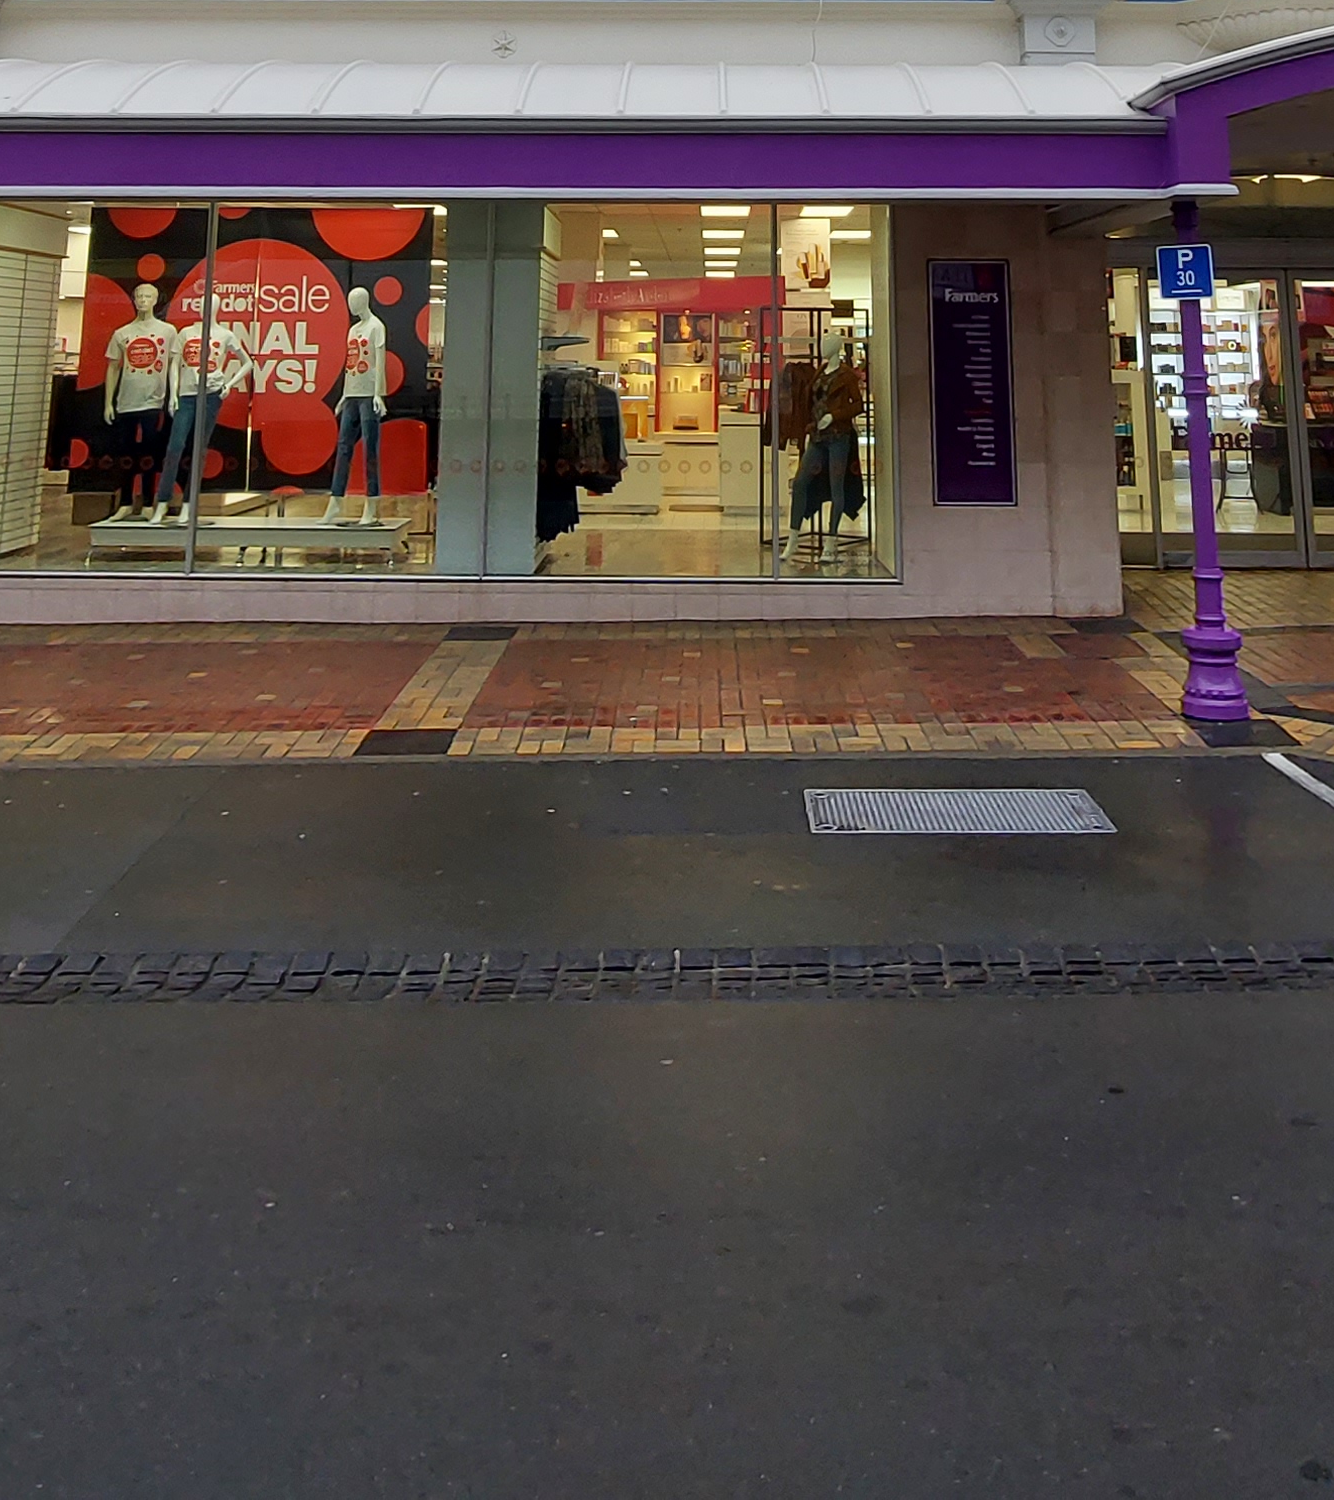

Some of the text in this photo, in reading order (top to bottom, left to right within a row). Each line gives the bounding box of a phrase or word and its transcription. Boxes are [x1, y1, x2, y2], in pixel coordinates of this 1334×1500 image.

[1178, 249, 1193, 269] P
[1177, 270, 1195, 286] 30
[221, 293, 254, 312] dot
[259, 275, 330, 313] sale
[944, 288, 999, 303] Farmers
[216, 321, 319, 355] NAL
[222, 359, 317, 393] AYS!
